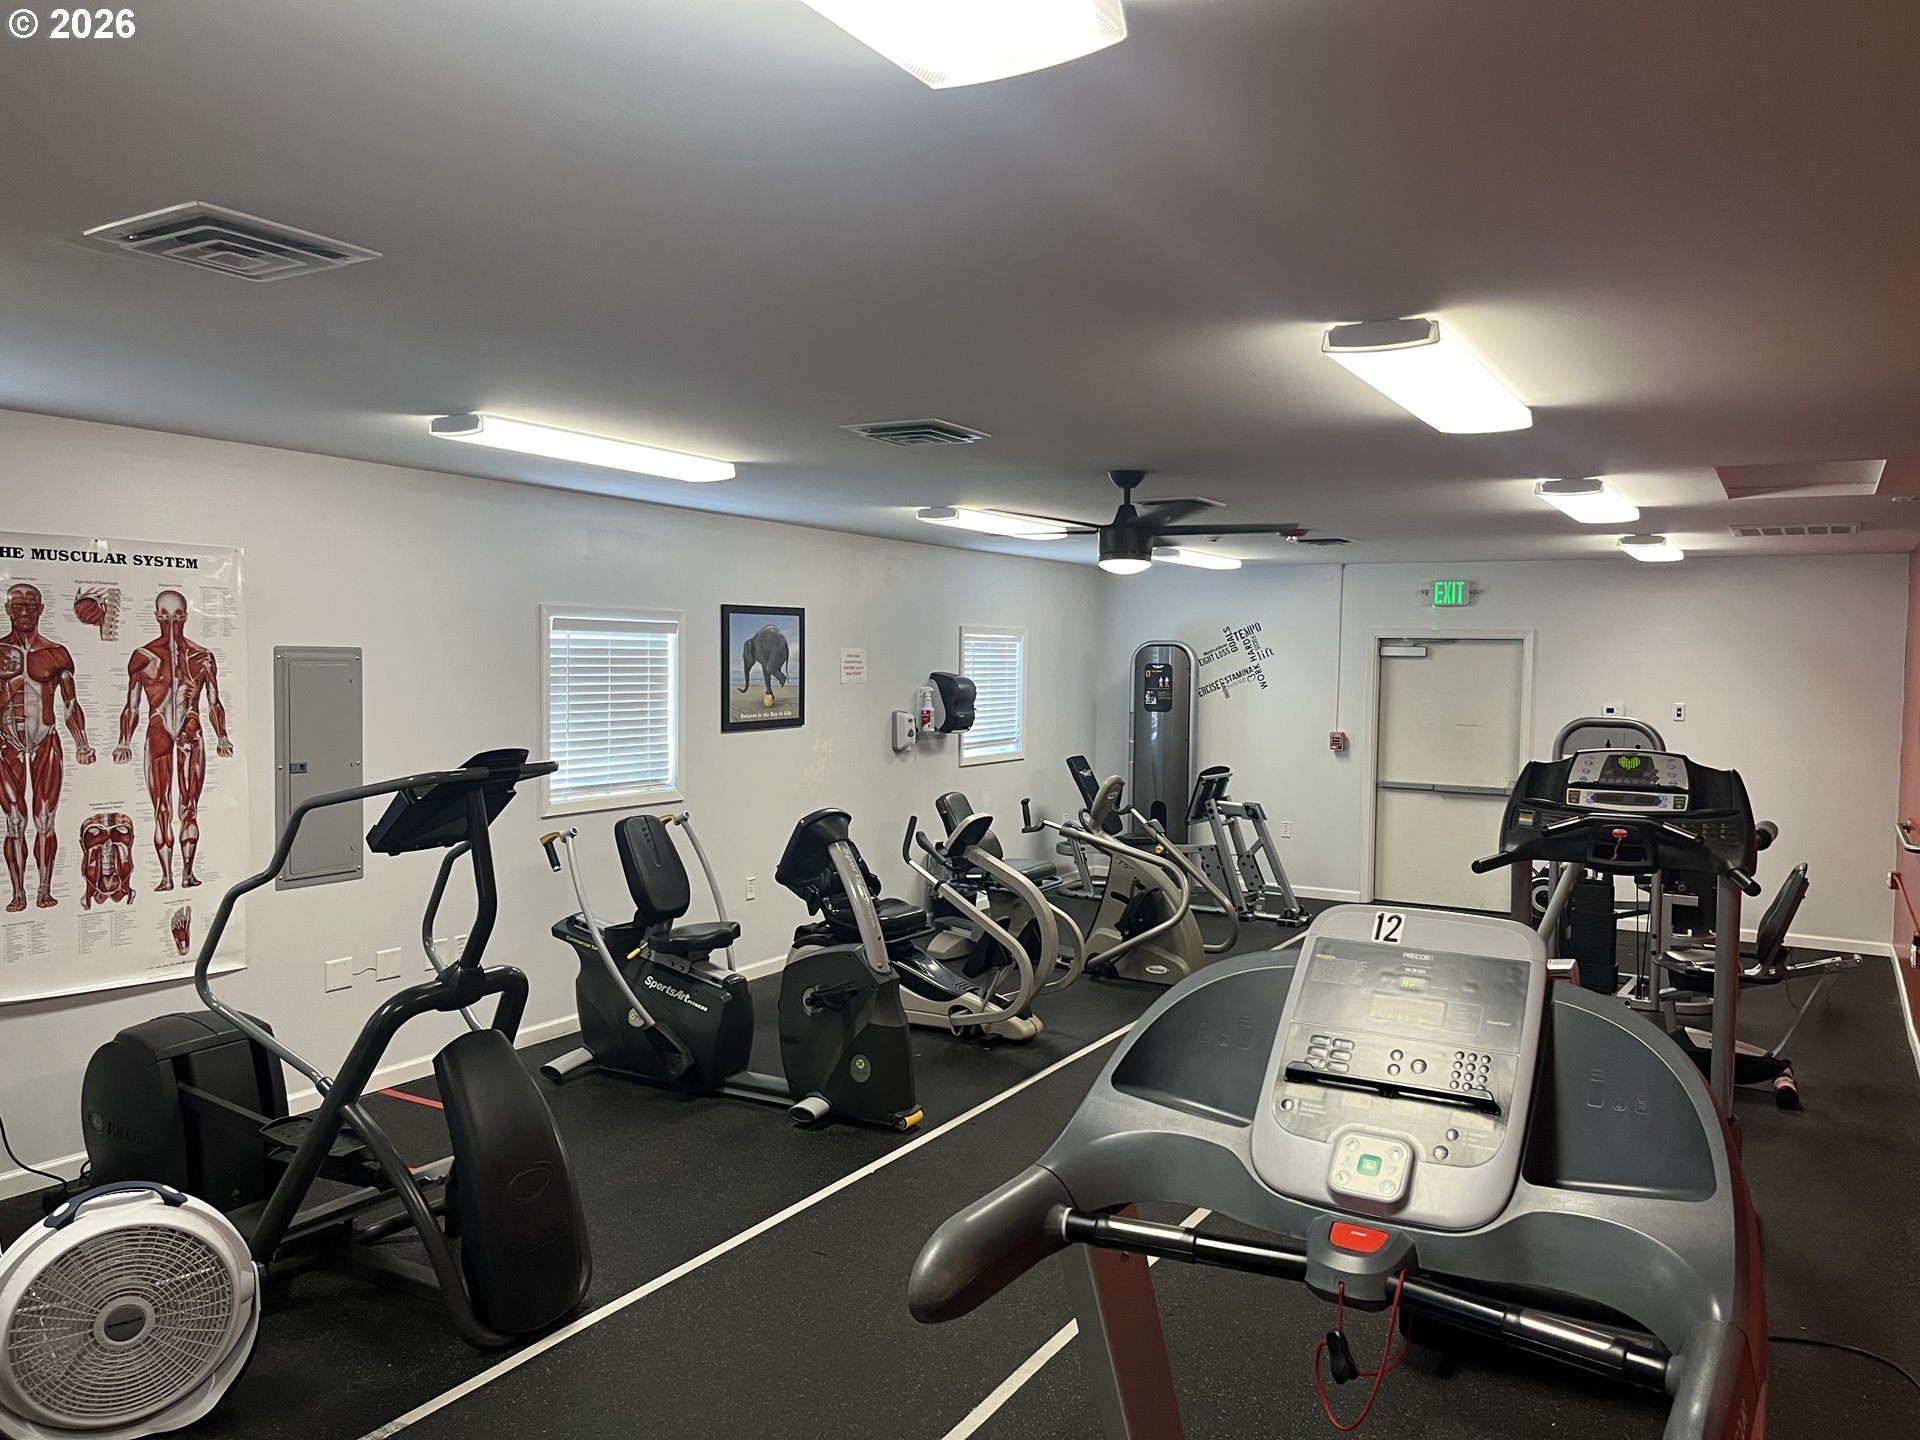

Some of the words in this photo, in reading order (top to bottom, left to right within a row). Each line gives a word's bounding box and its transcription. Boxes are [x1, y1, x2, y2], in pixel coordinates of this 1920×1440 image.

[31, 548, 127, 565] MUSCULAR
[133, 554, 199, 569] SYSTEM
[1434, 581, 1465, 605] EXIT
[1222, 626, 1238, 653] GOALS
[1233, 622, 1262, 642] TEMPO
[1214, 647, 1231, 660] LOSS
[1242, 638, 1258, 663] HARD
[1257, 647, 1274, 661] lift
[1223, 666, 1254, 684] STAMINA
[1252, 663, 1268, 690] WORK
[1374, 913, 1403, 943] 12
[644, 976, 691, 1003] SportsArt
